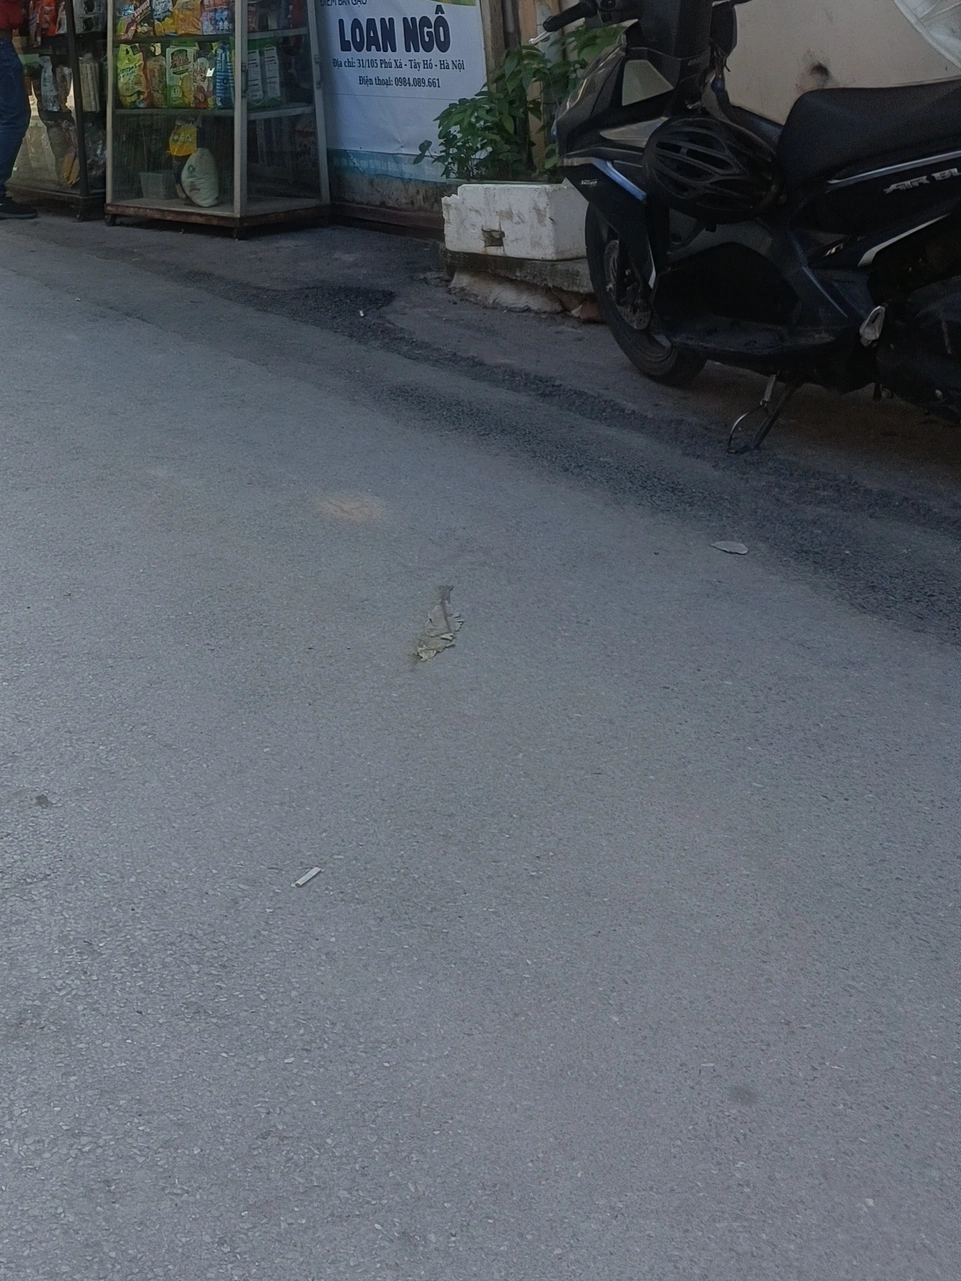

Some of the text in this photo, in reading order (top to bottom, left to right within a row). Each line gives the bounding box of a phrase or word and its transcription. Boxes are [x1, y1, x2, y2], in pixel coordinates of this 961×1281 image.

[338, 4, 451, 53] LOAN NGÔ
[333, 58, 343, 69] Địa
[357, 58, 379, 69] 31/105
[379, 58, 392, 69] Phú
[393, 58, 403, 69] Xá
[408, 58, 421, 72] Tây
[439, 59, 450, 70] Hà
[451, 60, 466, 72] Nội
[359, 75, 374, 88] Điện
[394, 76, 441, 89] 0984.089.661
